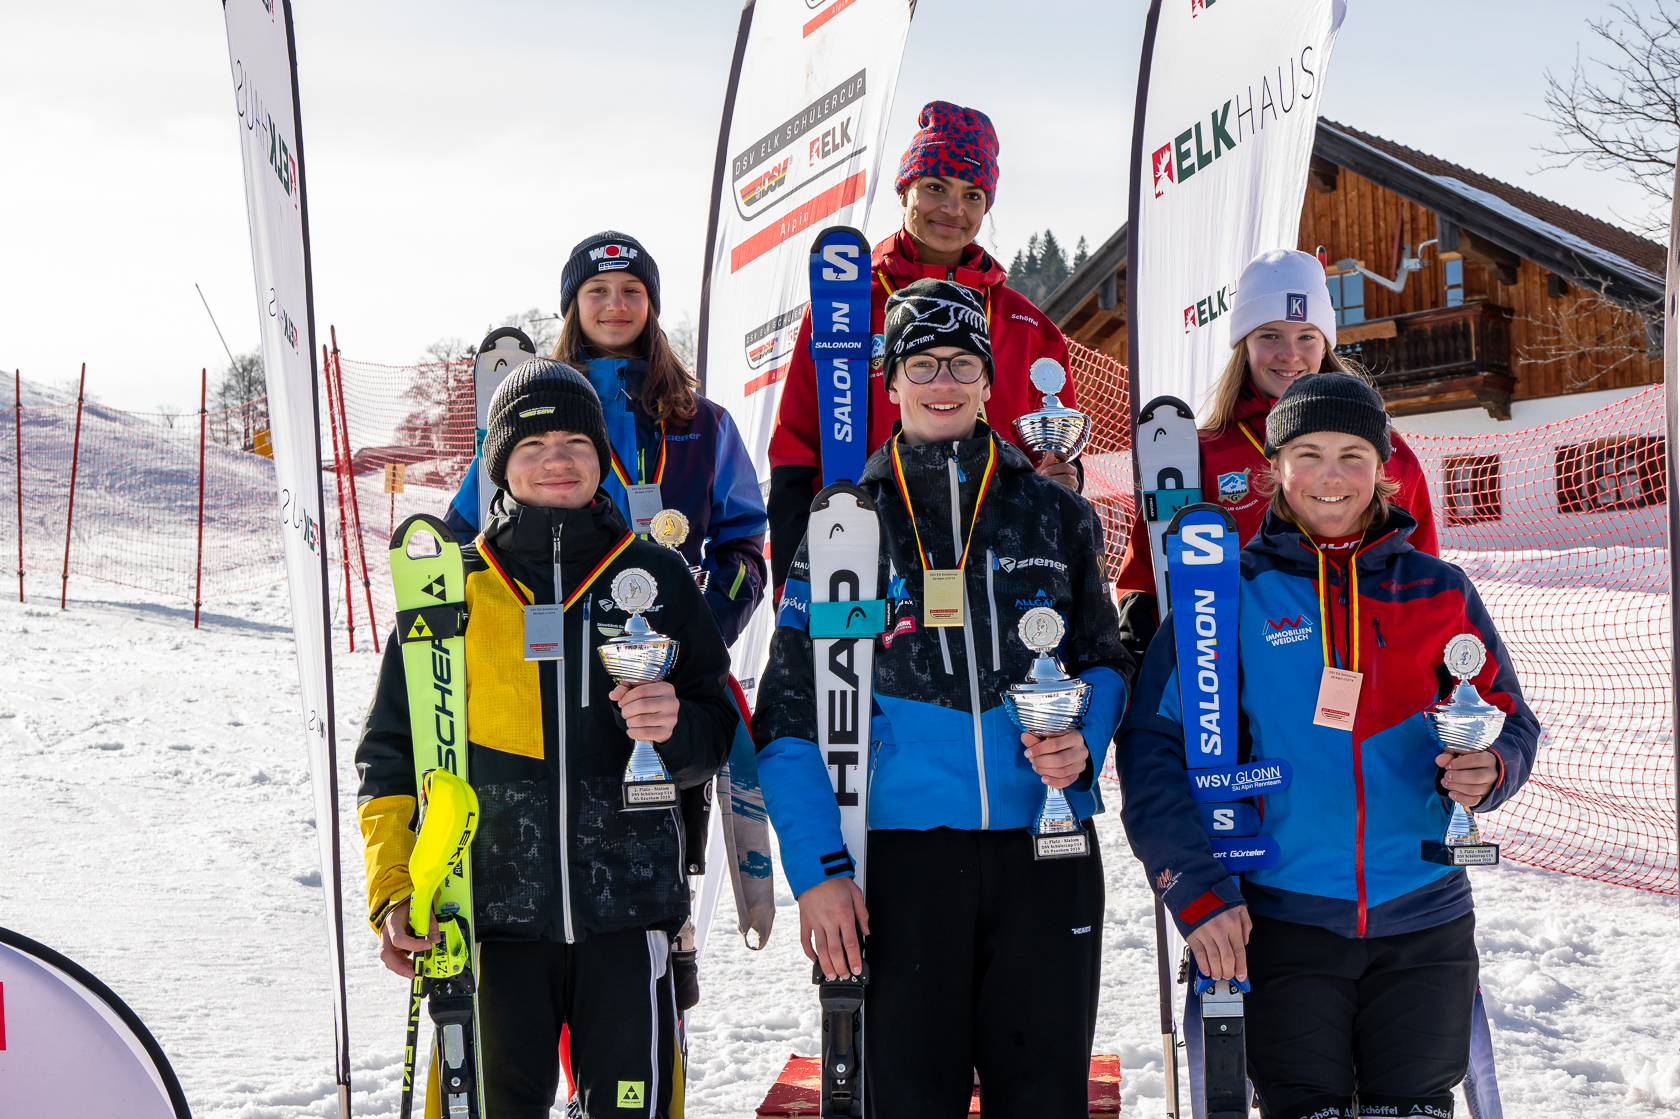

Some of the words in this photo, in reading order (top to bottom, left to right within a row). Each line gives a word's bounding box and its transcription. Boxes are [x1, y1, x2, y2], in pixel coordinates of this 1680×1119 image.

[735, 155, 754, 175] DSV
[761, 134, 780, 157] ELK
[786, 77, 863, 140] SCHÜLERCUP
[821, 117, 852, 159] ELK
[779, 211, 809, 236] Alpin
[1011, 313, 1039, 326] Schöffel
[815, 341, 862, 349] SALOMON
[1017, 557, 1068, 571] ziener
[1265, 627, 1312, 642] IMMOBILIEN
[1271, 633, 1309, 647] WEIDLICH
[1194, 589, 1222, 756] SALOMON
[1195, 774, 1231, 788] WSV
[1235, 766, 1281, 784] GLONN
[1241, 783, 1254, 791] Alpin
[1254, 779, 1281, 788] Rennteam
[446, 811, 475, 866] LEKI
[1360, 1105, 1398, 1115] Schöffel
